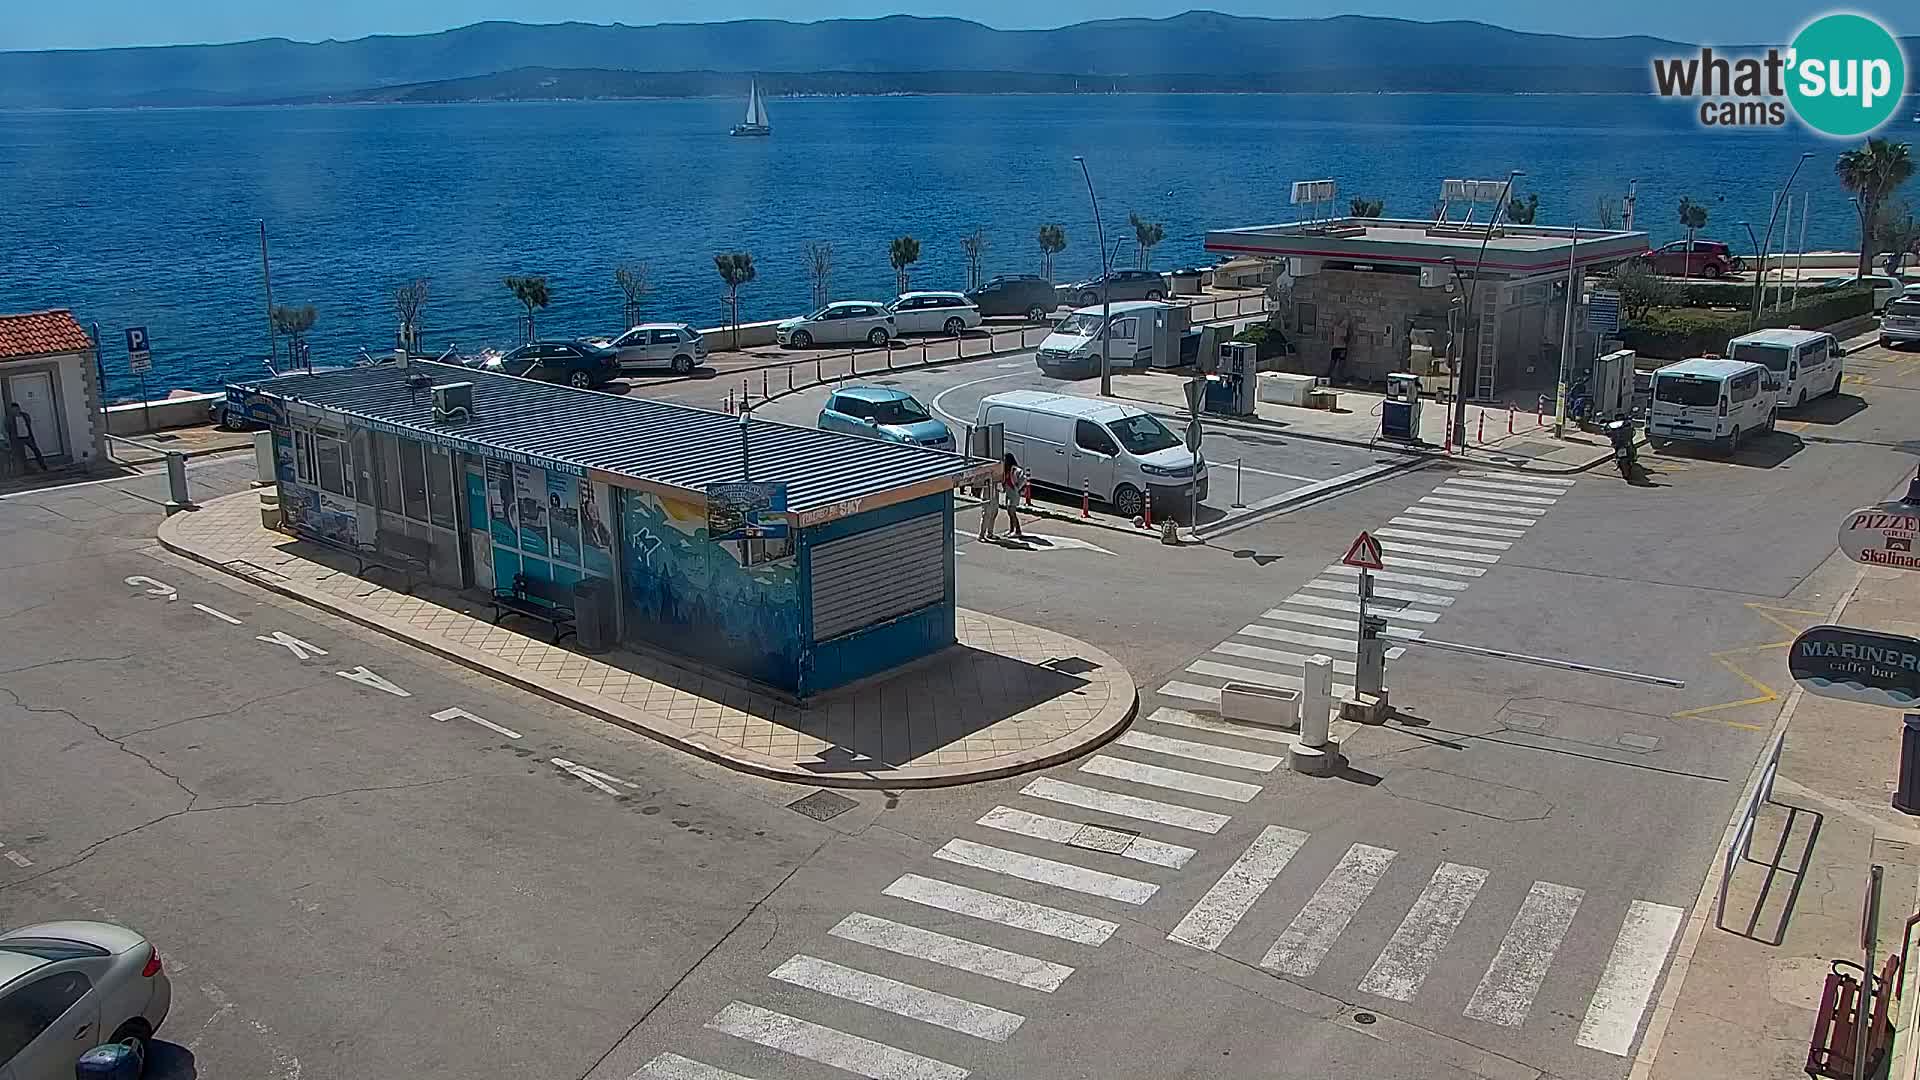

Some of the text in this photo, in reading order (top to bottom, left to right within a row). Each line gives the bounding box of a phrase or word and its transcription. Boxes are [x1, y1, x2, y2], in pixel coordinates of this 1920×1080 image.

[131, 330, 143, 349] P
[397, 426, 437, 443] AUTOBUSNA
[438, 436, 469, 451] POSTAJA
[480, 445, 494, 457] BUS
[495, 449, 527, 465] STATION
[529, 456, 555, 471] TICKET
[556, 462, 583, 476] OFFICE
[1848, 514, 1920, 533] PIZZE
[1830, 661, 1898, 679] caffe bar
